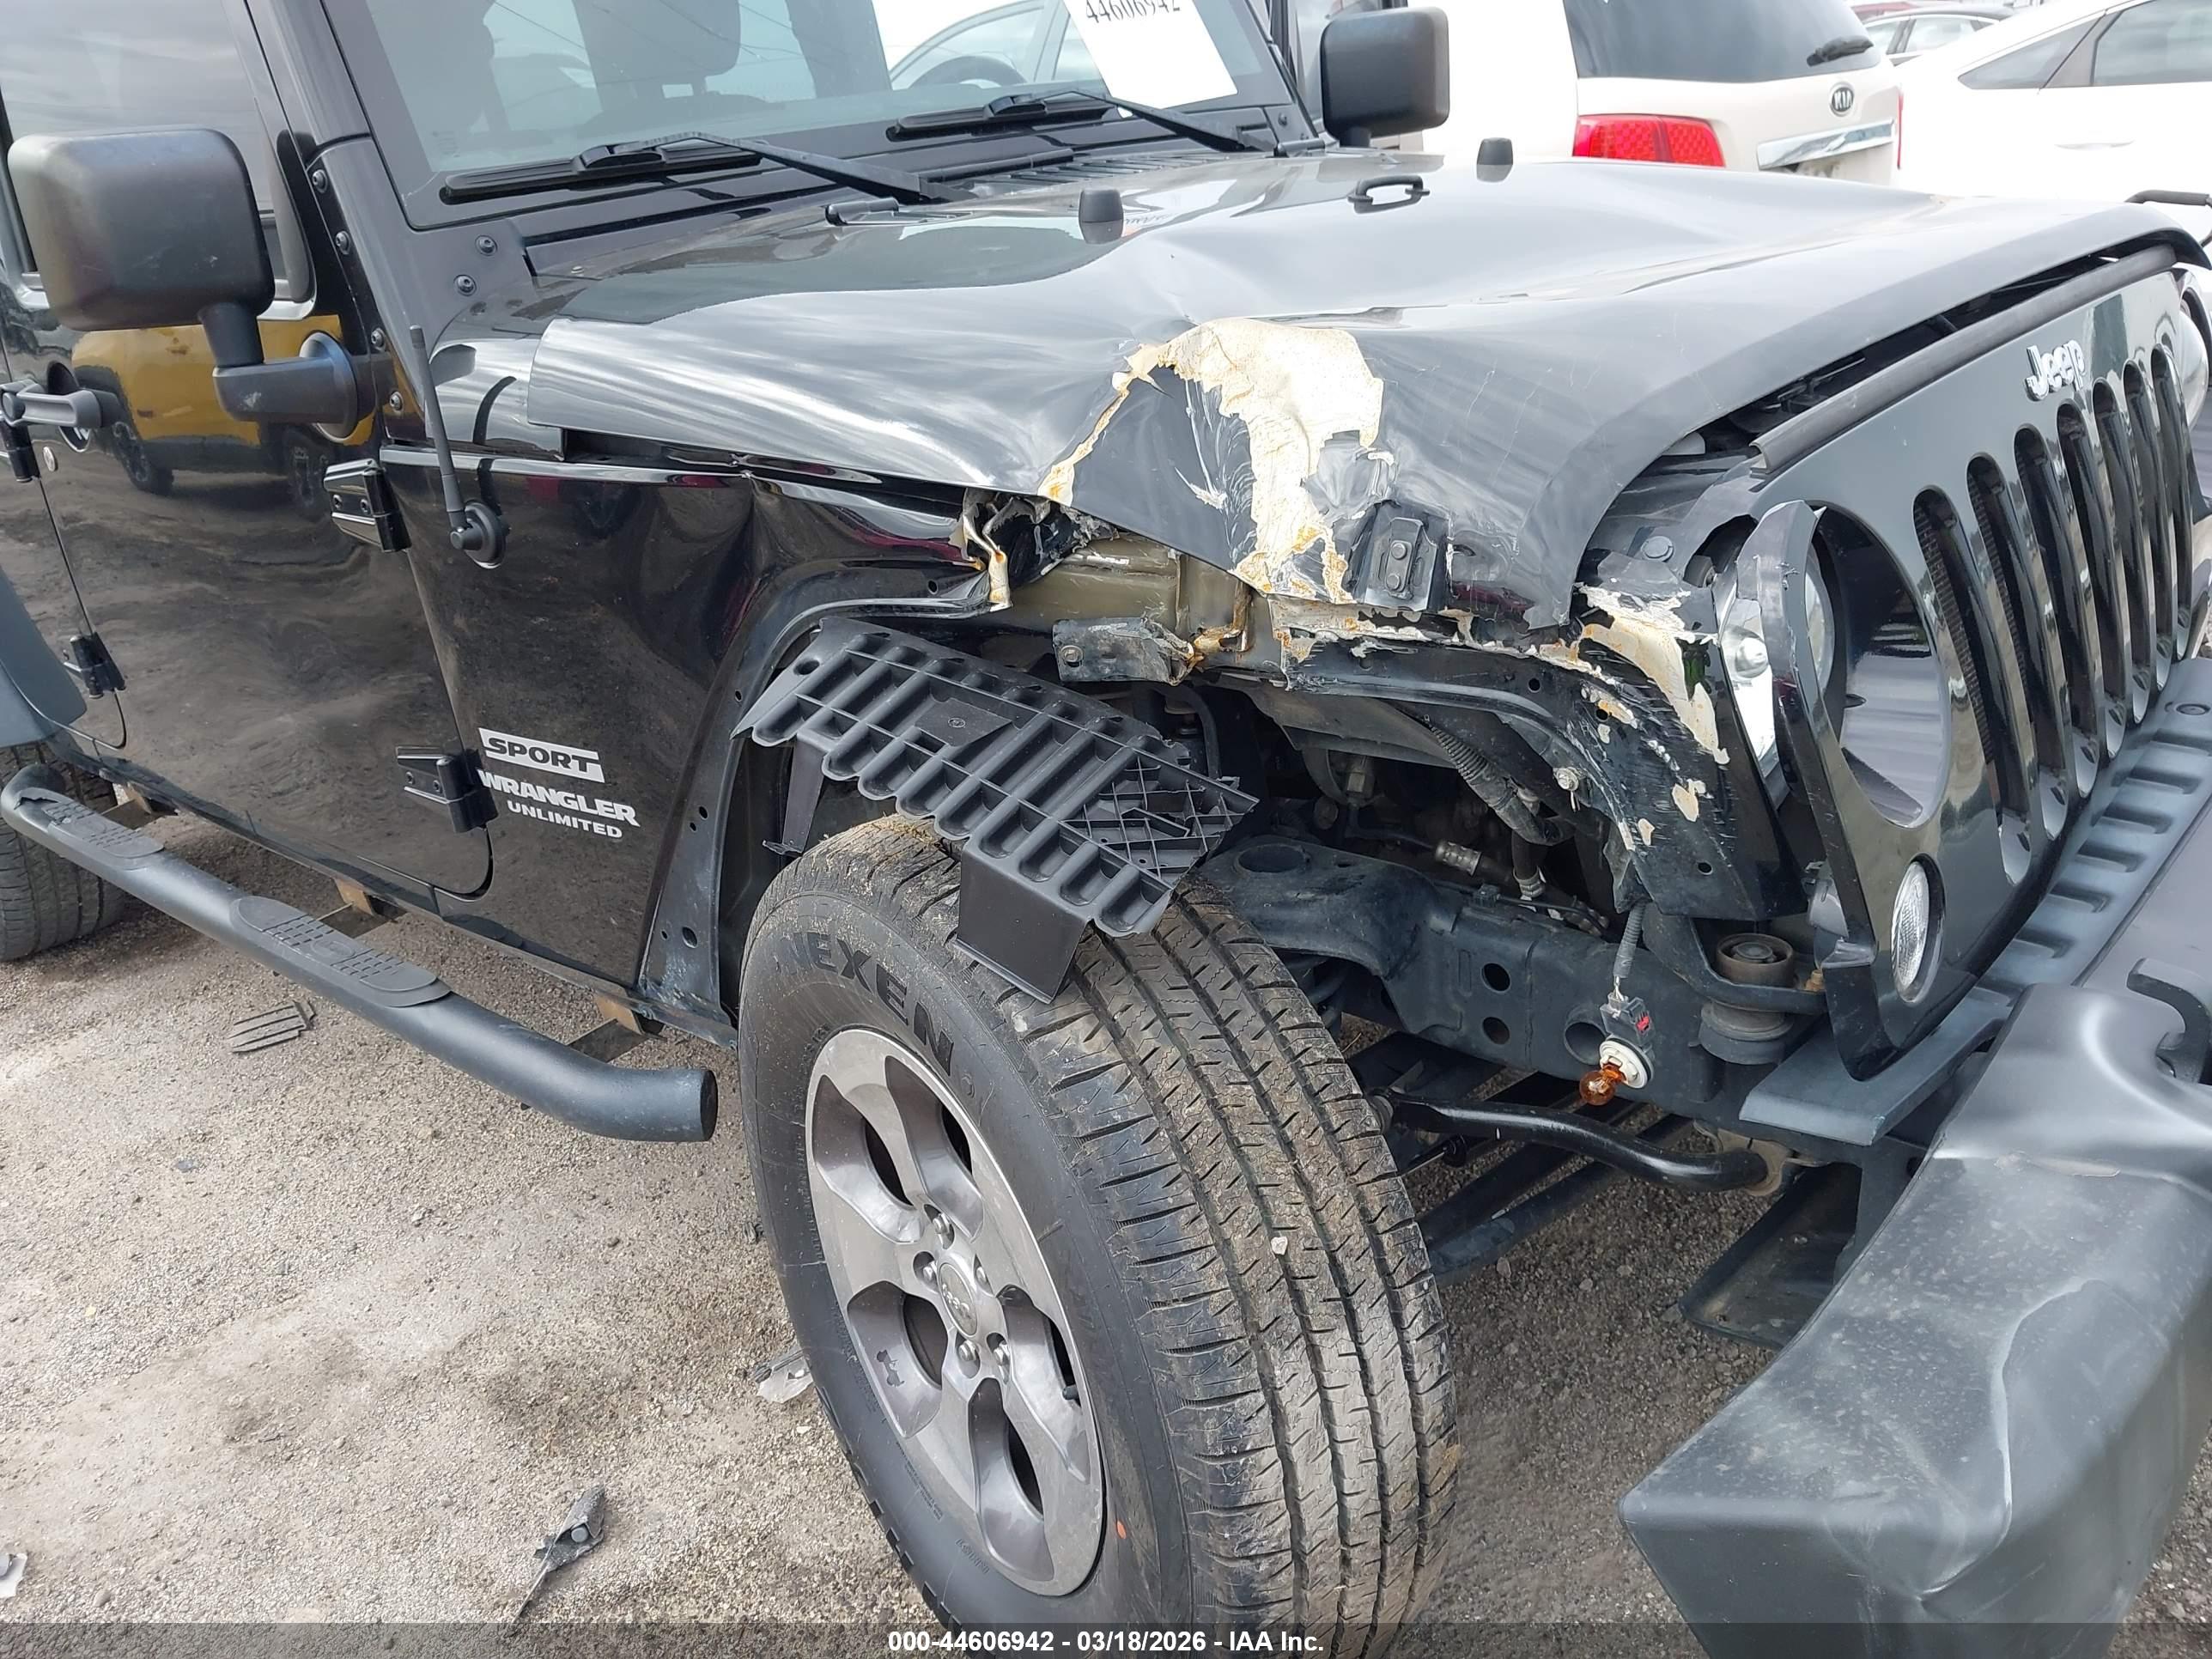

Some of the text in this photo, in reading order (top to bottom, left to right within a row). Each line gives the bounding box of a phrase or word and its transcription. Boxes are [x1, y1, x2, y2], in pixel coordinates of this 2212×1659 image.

[1833, 88, 1853, 111] KIA
[2025, 339, 2086, 401] Jeep
[488, 737, 602, 774] SPORT
[477, 768, 641, 827] WRANGLER
[507, 799, 623, 839] UNLIMITED
